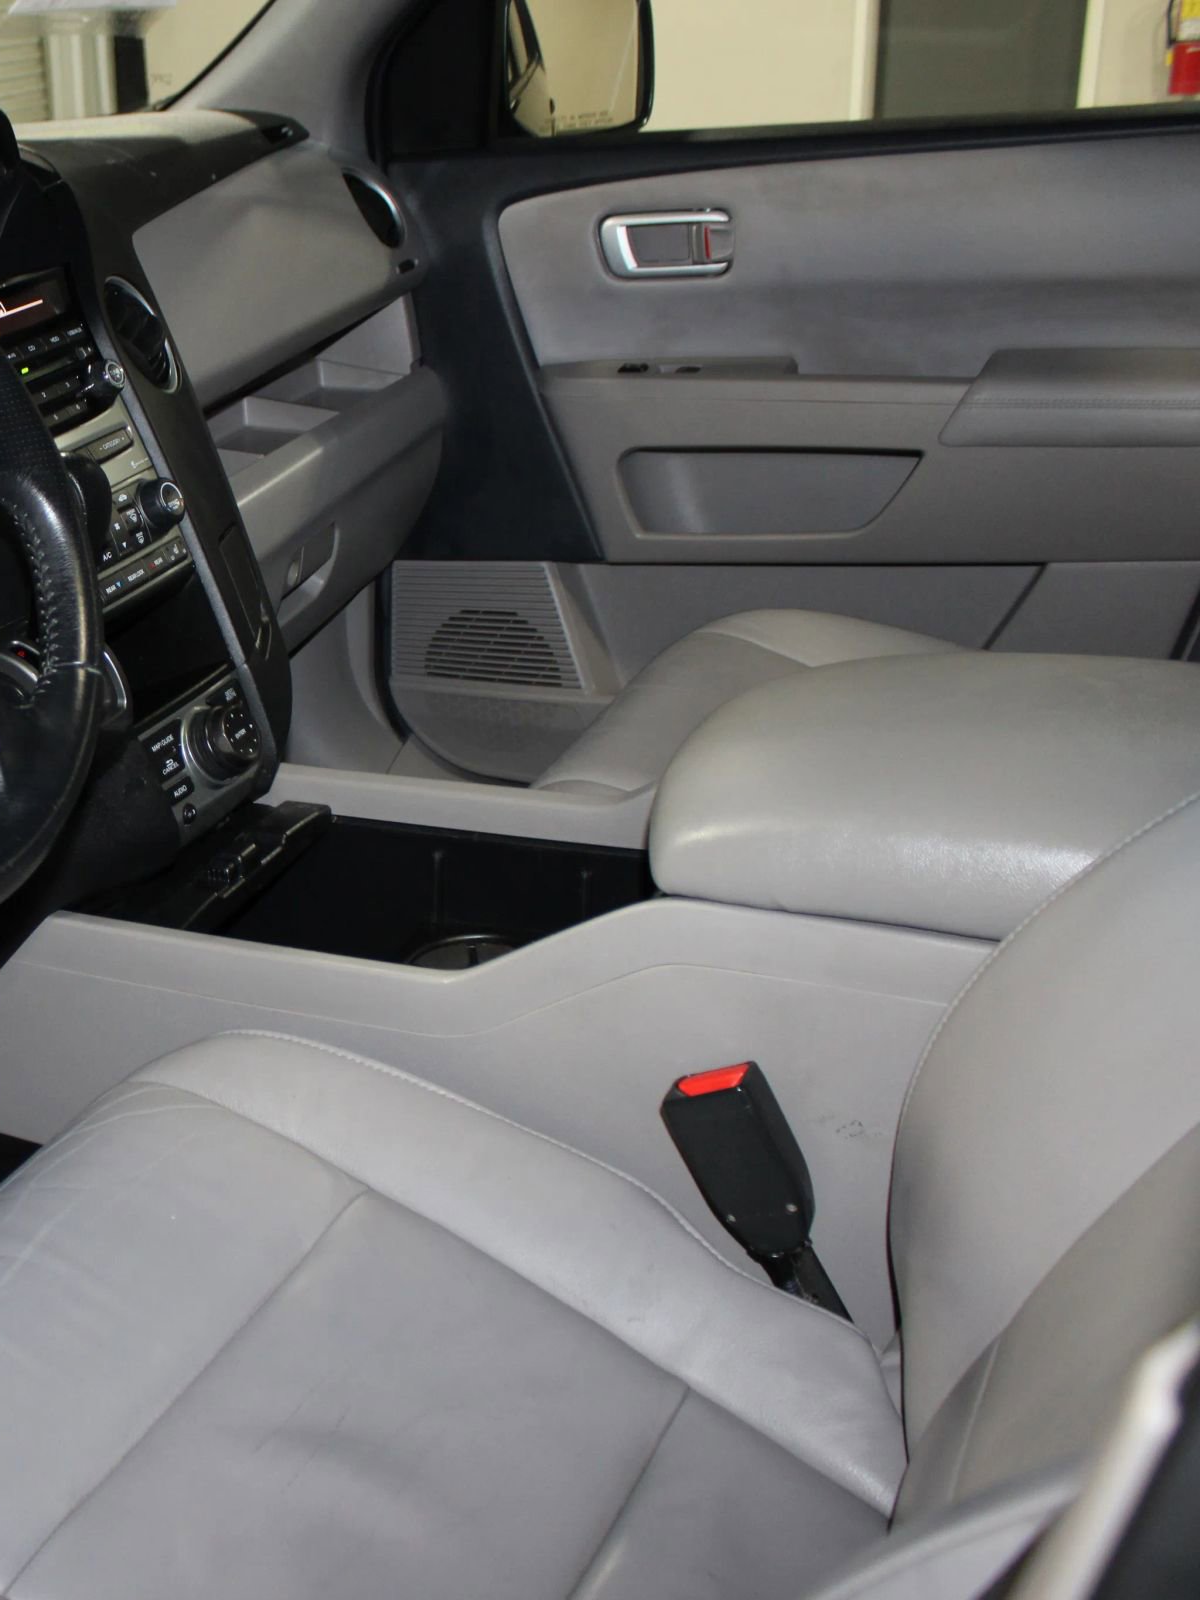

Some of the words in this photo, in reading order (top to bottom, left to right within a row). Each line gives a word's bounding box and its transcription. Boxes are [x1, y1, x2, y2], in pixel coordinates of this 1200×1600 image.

[102, 551, 113, 561] A/C
[162, 762, 180, 776] CANCEL
[173, 784, 188, 798] AUDIO
